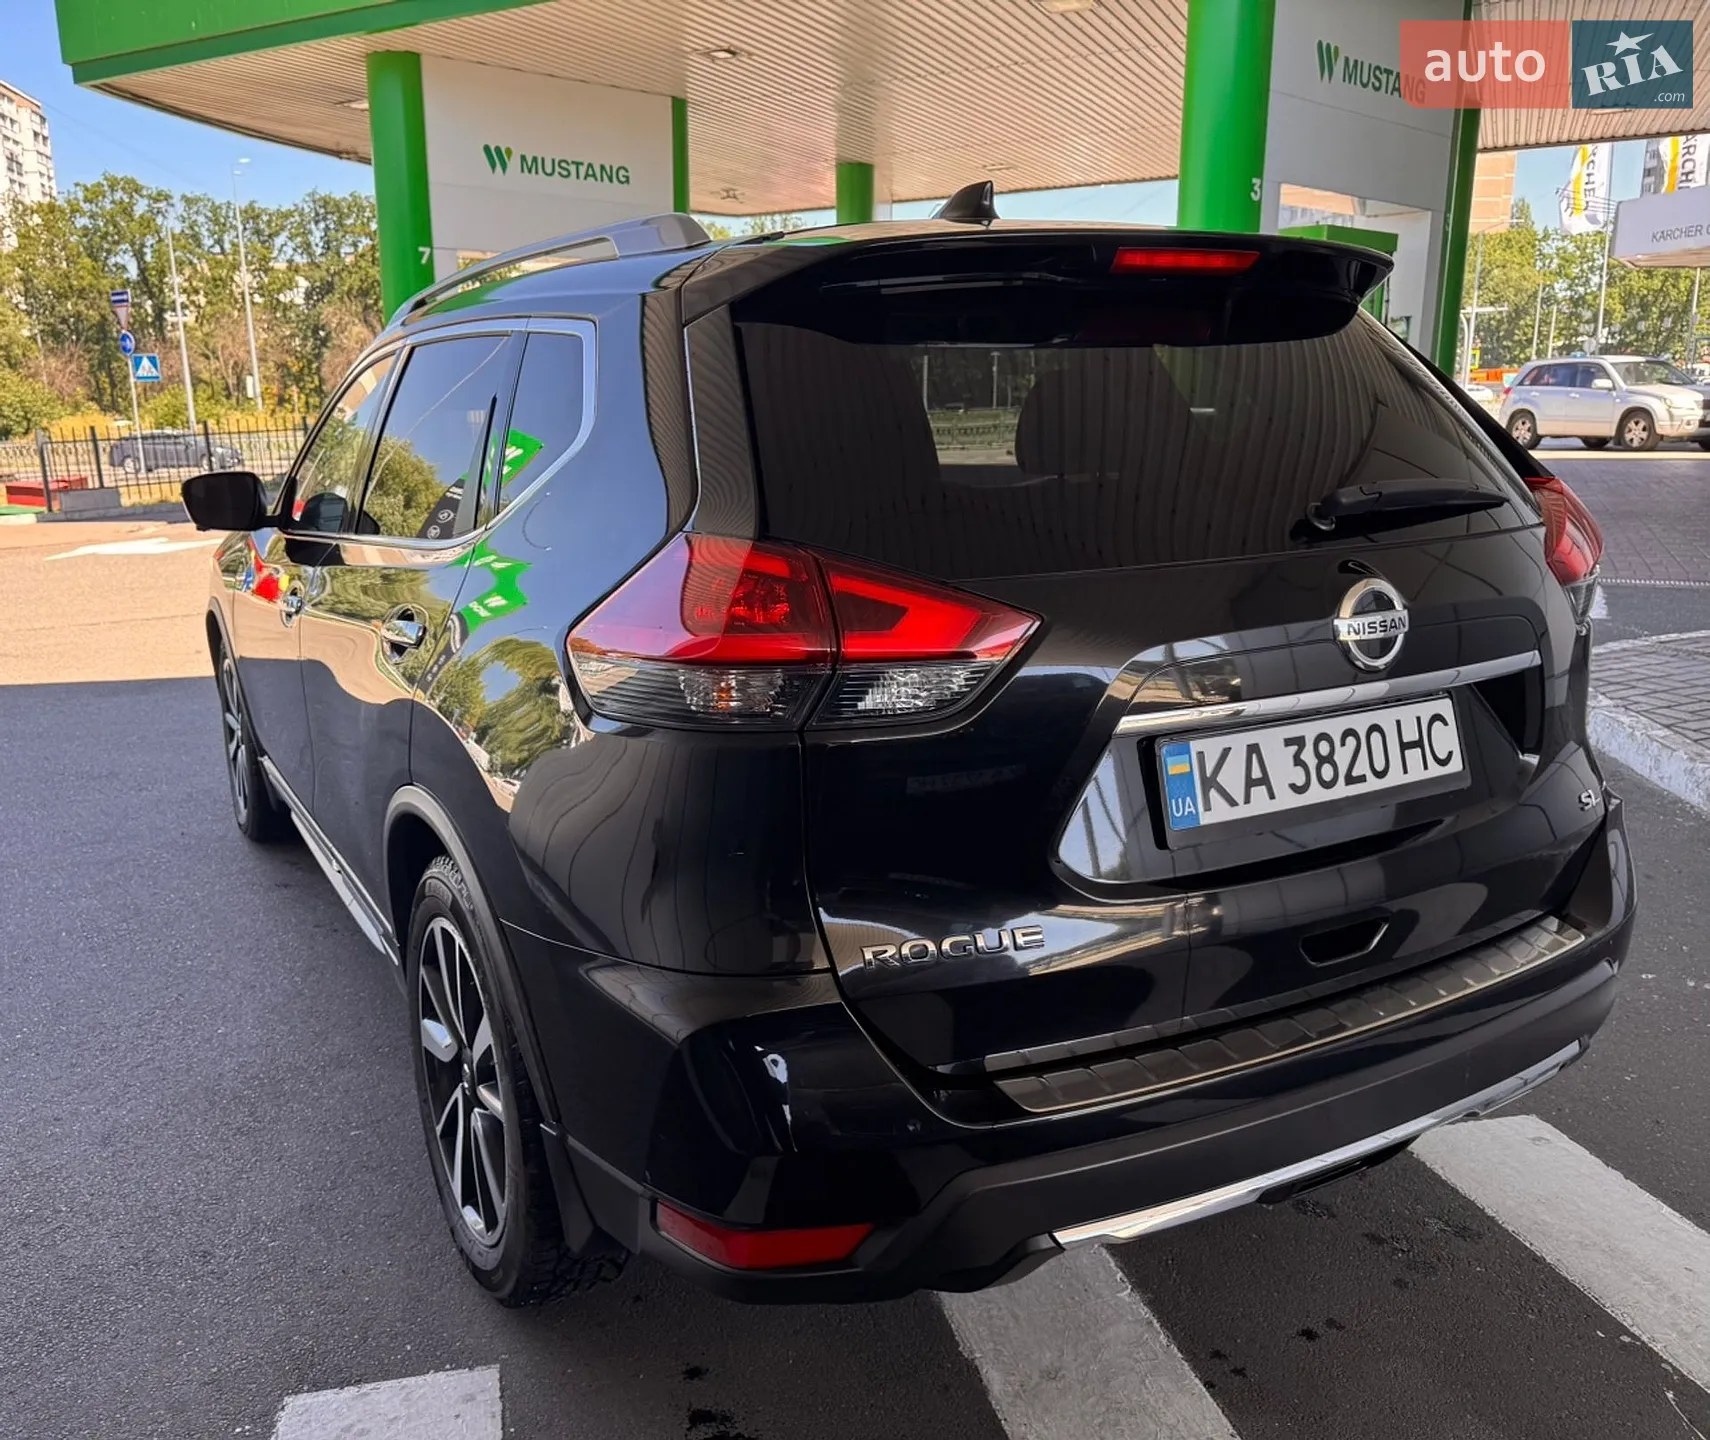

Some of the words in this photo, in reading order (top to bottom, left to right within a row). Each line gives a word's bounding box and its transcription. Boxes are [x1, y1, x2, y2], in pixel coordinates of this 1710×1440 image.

[1342, 56, 1426, 104] MUSTANG
[520, 154, 631, 185] MUSTANG
[1250, 178, 1261, 201] 3
[418, 246, 431, 264] 7
[1347, 616, 1406, 636] NISSAN
[1197, 742, 1276, 812] KA
[1283, 723, 1390, 795] 3820
[1395, 713, 1454, 775] HC
[1172, 797, 1196, 817] UA
[1579, 789, 1601, 811] SL
[860, 924, 1045, 970] ROGUE
